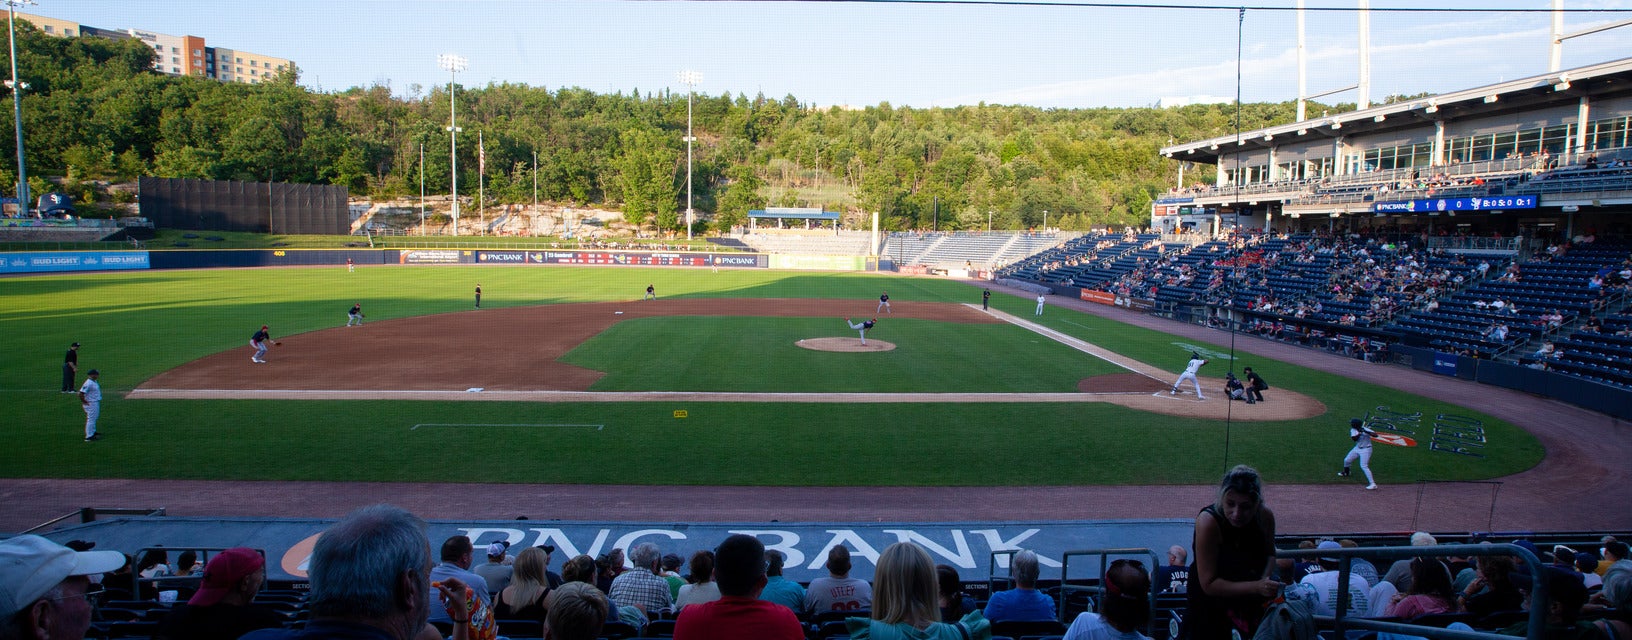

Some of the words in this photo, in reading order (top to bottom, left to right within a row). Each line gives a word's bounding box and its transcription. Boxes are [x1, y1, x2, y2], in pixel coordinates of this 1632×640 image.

[457, 527, 687, 569] PNC
[728, 528, 1063, 569] BANK
[830, 585, 855, 598] UTLEY
